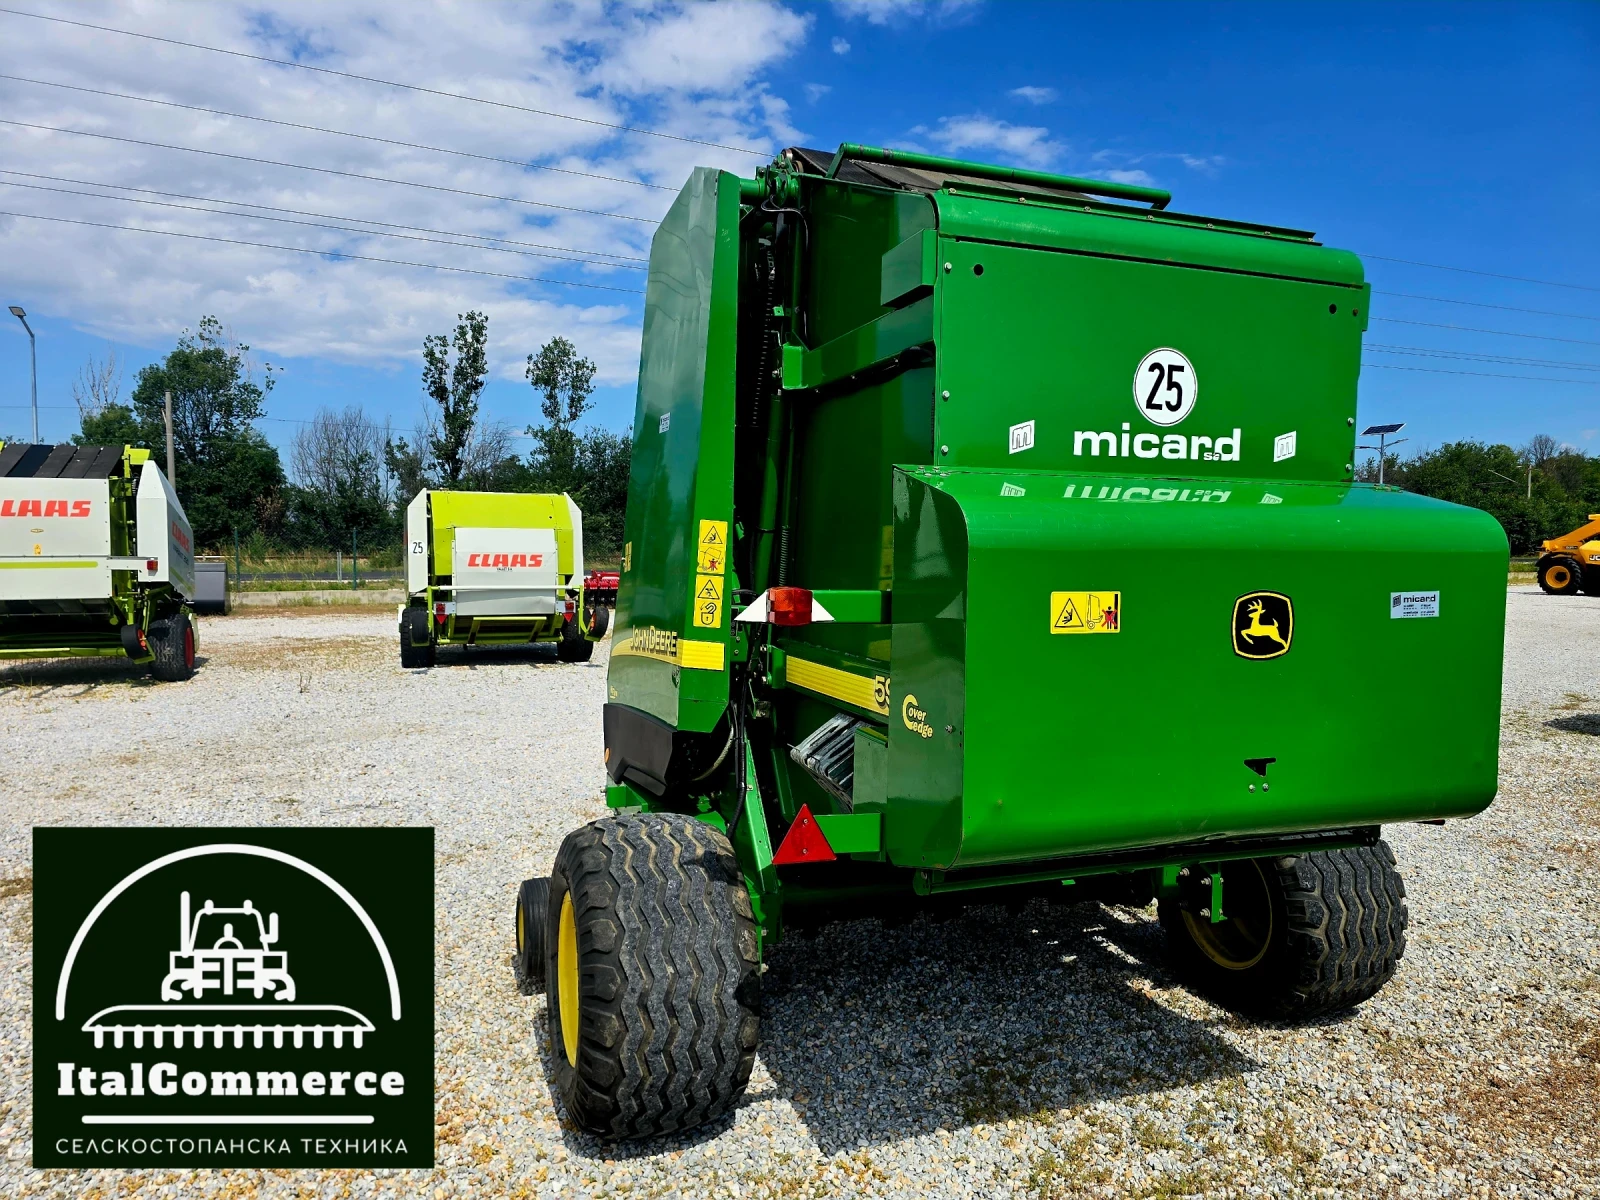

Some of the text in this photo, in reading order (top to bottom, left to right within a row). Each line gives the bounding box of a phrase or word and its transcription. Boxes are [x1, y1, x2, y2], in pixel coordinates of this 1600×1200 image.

[1145, 362, 1185, 412] 25
[1073, 422, 1241, 462] micard
[412, 541, 424, 554] 25
[467, 553, 543, 567] CLAAS
[1403, 594, 1436, 603] micard
